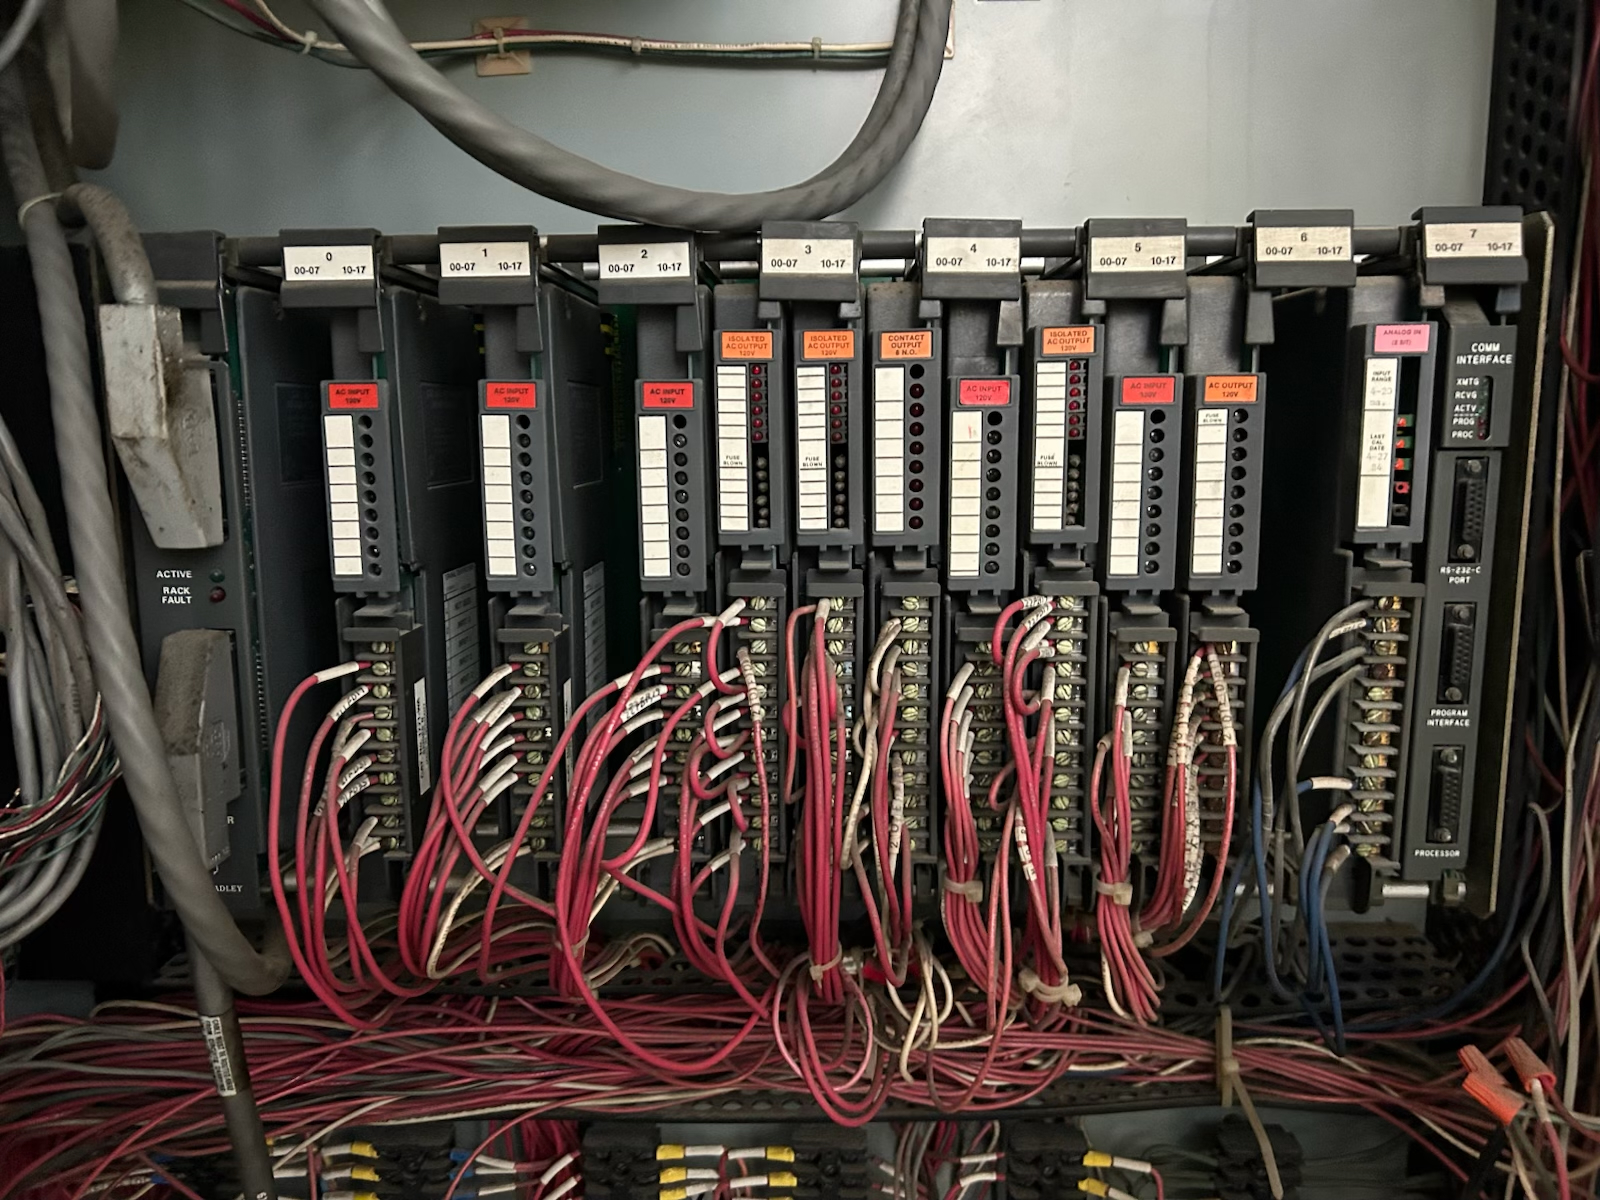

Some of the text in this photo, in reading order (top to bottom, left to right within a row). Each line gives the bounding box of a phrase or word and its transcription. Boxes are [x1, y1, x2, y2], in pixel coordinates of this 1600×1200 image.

[1300, 232, 1308, 242] 6
[1469, 228, 1477, 239] 7
[804, 244, 812, 255] 3
[969, 243, 977, 253] 4
[1134, 242, 1142, 253] 5
[1265, 246, 1343, 256] 00-07 10-17
[1434, 242, 1513, 252] 00-07 10-17
[325, 252, 333, 262] 0
[482, 248, 488, 258] 1
[640, 249, 649, 259] 2
[771, 259, 846, 269] 00-07 10-17
[935, 257, 1012, 267] 00-07 10-17
[1099, 256, 1177, 267] 00-07 10-17
[294, 265, 367, 275] 00-07 10-17
[449, 261, 523, 272] 00-07 10-17
[608, 262, 682, 273] 00-07 10-17
[1049, 330, 1088, 338] ISOLATED
[1383, 328, 1422, 336] ANALOG IN
[728, 335, 766, 343] ISOLATED
[888, 334, 925, 342] CONTACT
[1047, 337, 1091, 346] AC OUTPUT
[808, 342, 850, 350] AC OUTPUT
[890, 341, 923, 349] OUTPUT
[1471, 342, 1501, 353] COMM
[821, 349, 838, 357] 120V
[901, 348, 918, 356] N.O.
[1456, 354, 1513, 365] INTERFACE
[1456, 377, 1479, 386] XMTG
[1143, 382, 1168, 390] INPUT
[336, 388, 371, 396] AC INPUT
[494, 387, 529, 395] AC INPUT
[1454, 391, 1477, 399] RCVG
[1454, 404, 1477, 412] ACTV
[1452, 417, 1475, 425] PROG
[1452, 430, 1474, 438] PROC
[156, 570, 192, 578] ACTIVE
[1440, 566, 1481, 574] RS-232-C
[1449, 576, 1471, 584] PORT
[162, 596, 192, 604] FAULT
[1430, 709, 1468, 717] PROGRAM
[1427, 719, 1470, 727] INTERFACE
[1414, 849, 1461, 857] PROCESSOR
